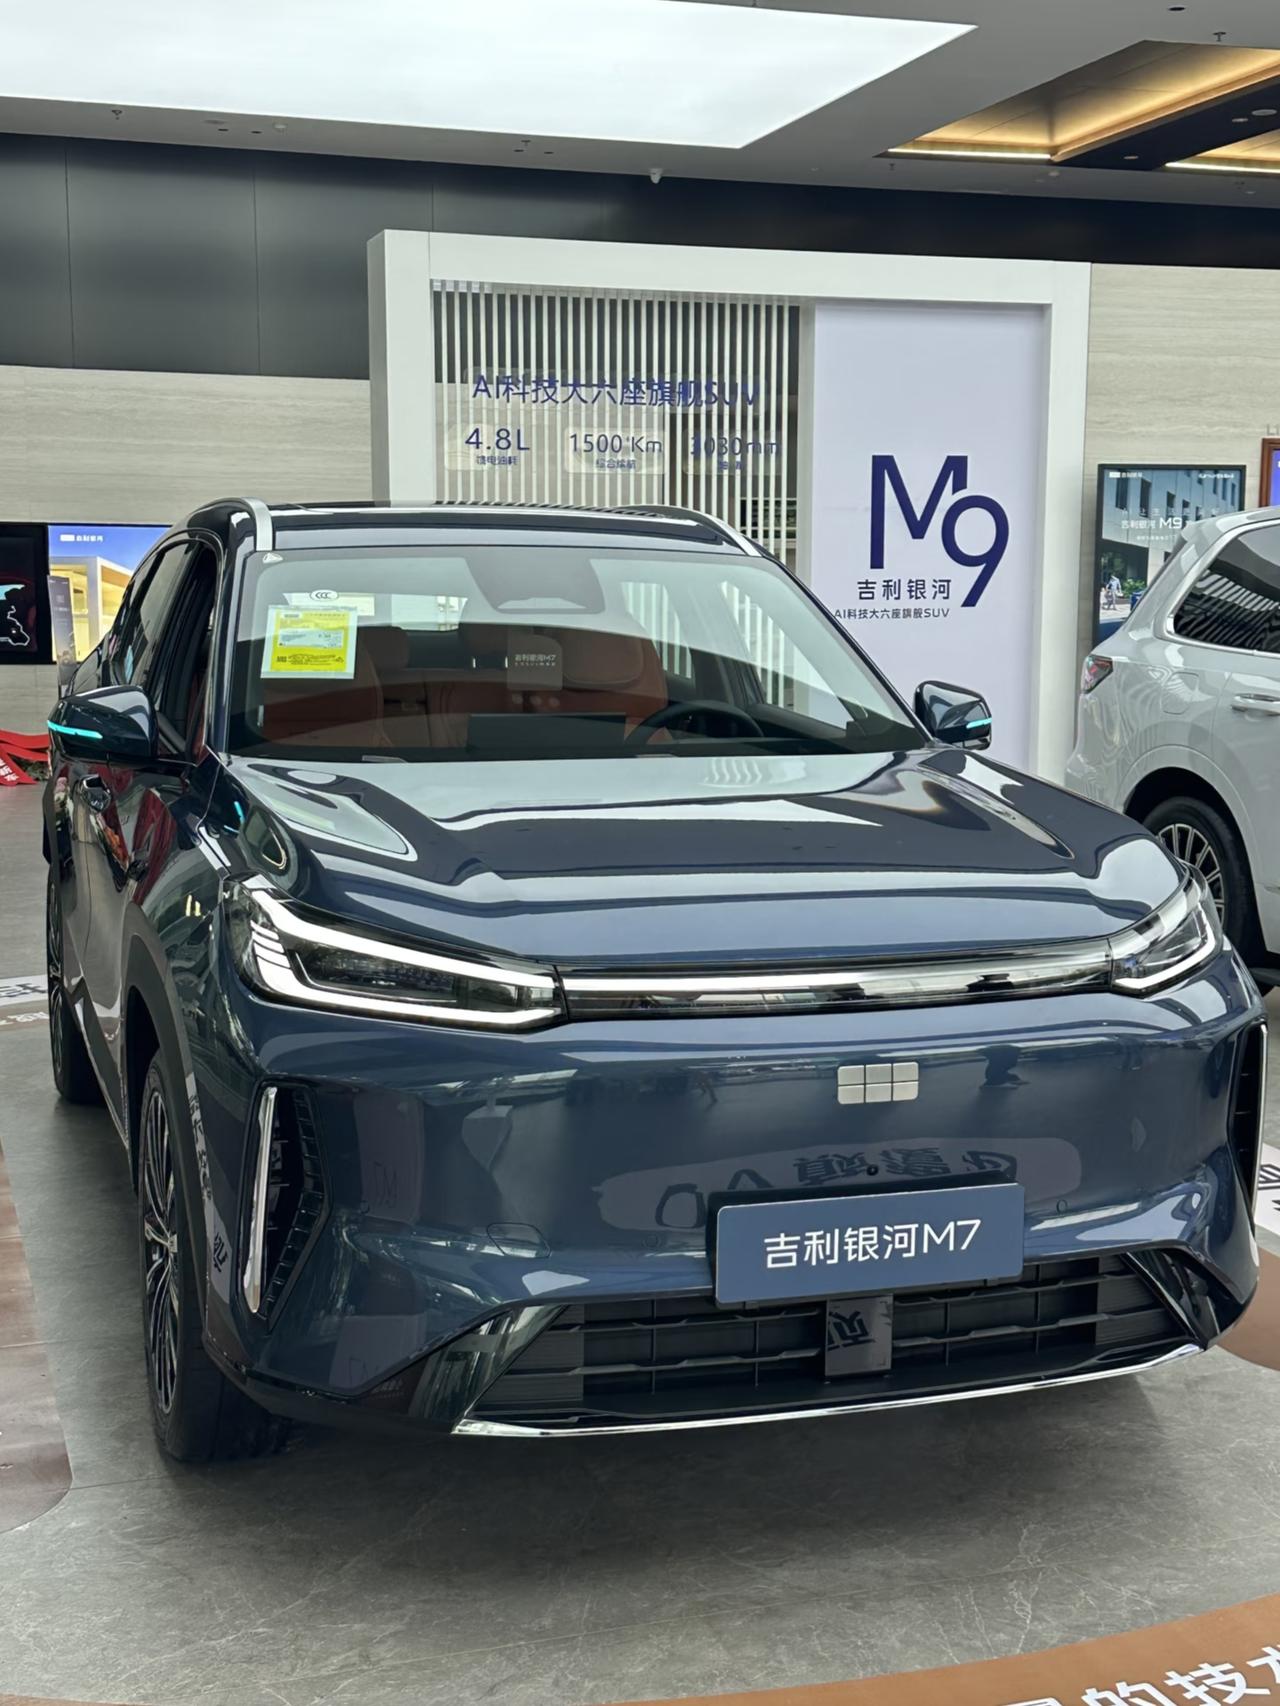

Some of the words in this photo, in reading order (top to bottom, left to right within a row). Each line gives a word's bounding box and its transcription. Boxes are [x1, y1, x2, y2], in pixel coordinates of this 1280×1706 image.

[465, 428, 530, 451] 4.8L
[869, 454, 1010, 608] M9
[1159, 517, 1183, 529] M9
[857, 579, 952, 601] 吉利银河
[834, 607, 950, 620] AI科技大六座旗舰SUV
[763, 1218, 982, 1271] 吉利银河M7
